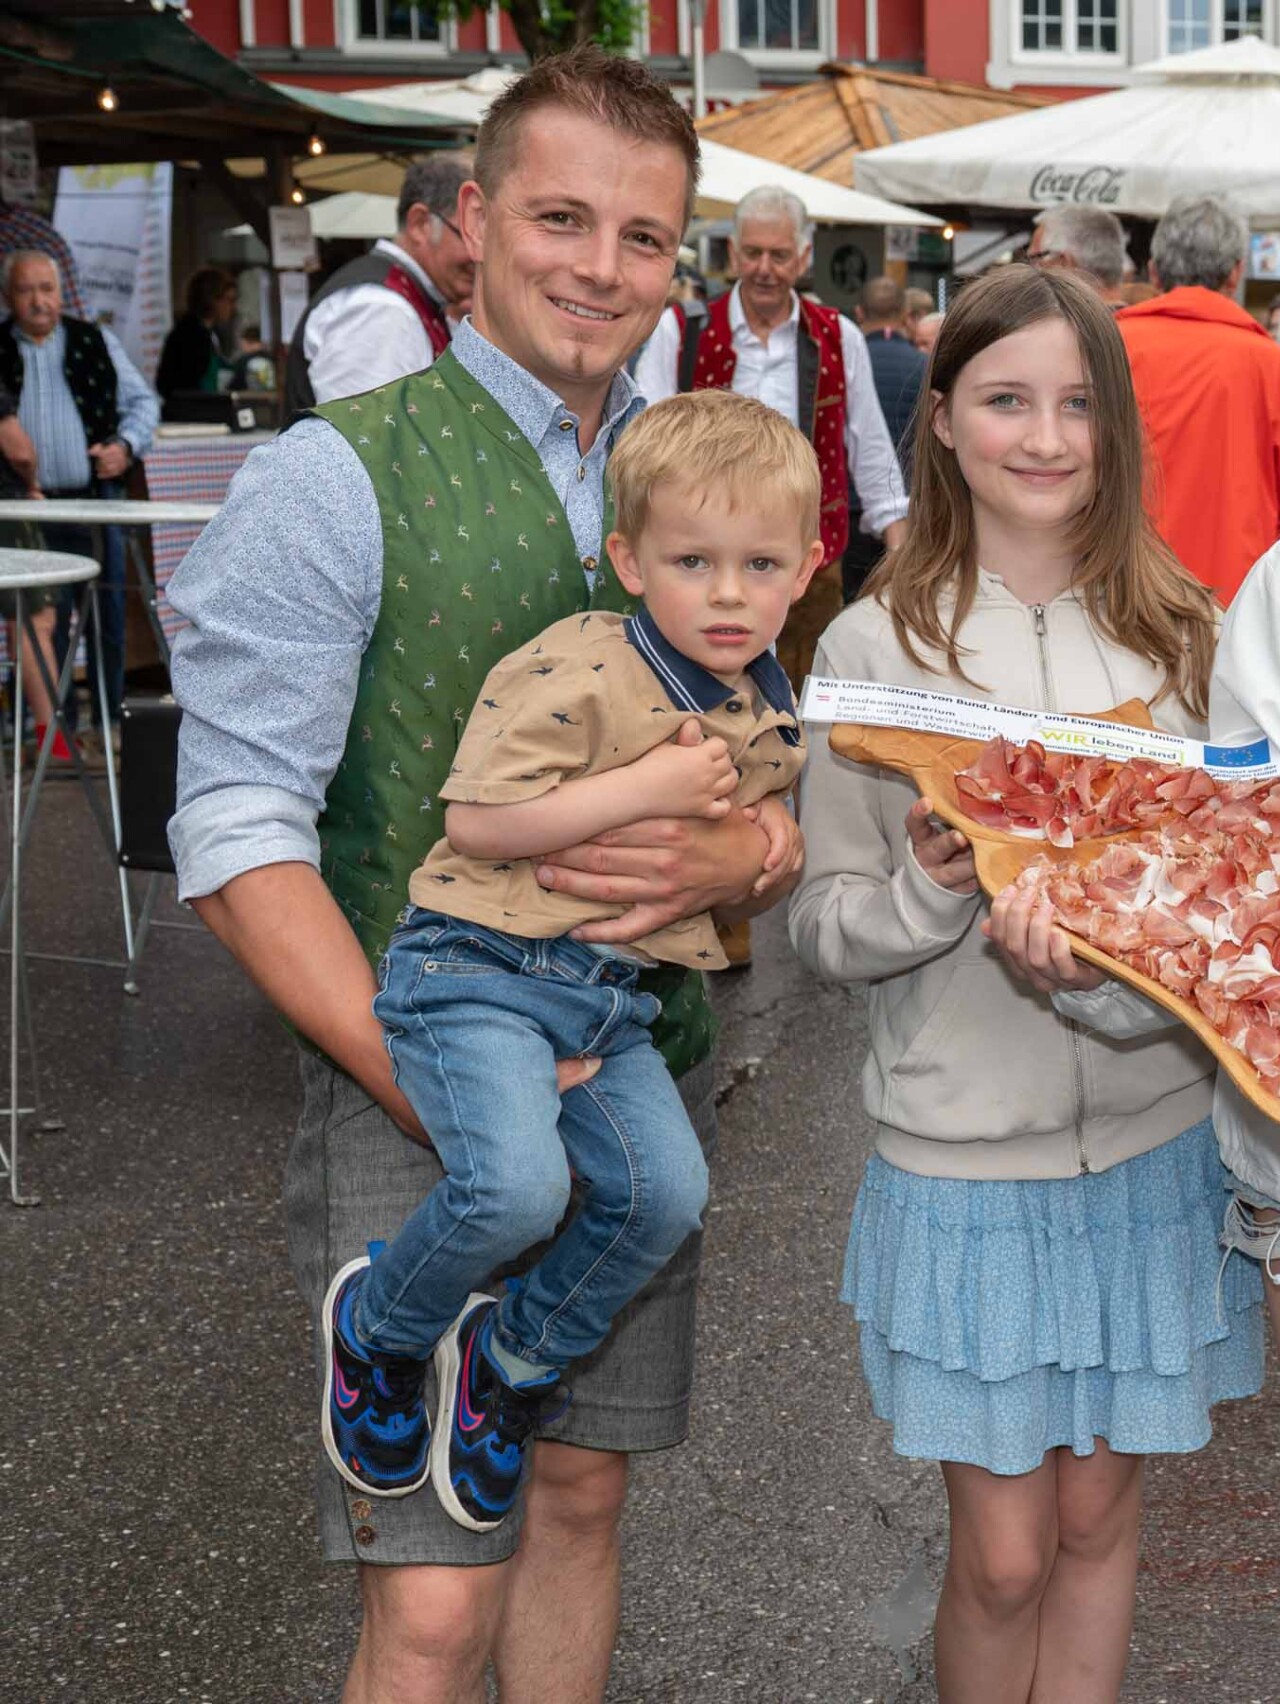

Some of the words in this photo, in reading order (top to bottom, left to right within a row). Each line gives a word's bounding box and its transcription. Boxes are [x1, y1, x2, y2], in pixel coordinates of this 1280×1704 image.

[817, 680, 838, 689] Mit
[842, 682, 928, 699] Unterstützung
[931, 693, 954, 703] von
[956, 698, 991, 711] Bund,
[1044, 714, 1068, 722] und
[1070, 719, 1147, 738] Europäischer
[1149, 733, 1185, 745] Union
[1040, 730, 1087, 746] WIR
[1092, 737, 1134, 752] leben
[1139, 747, 1177, 760] Land
